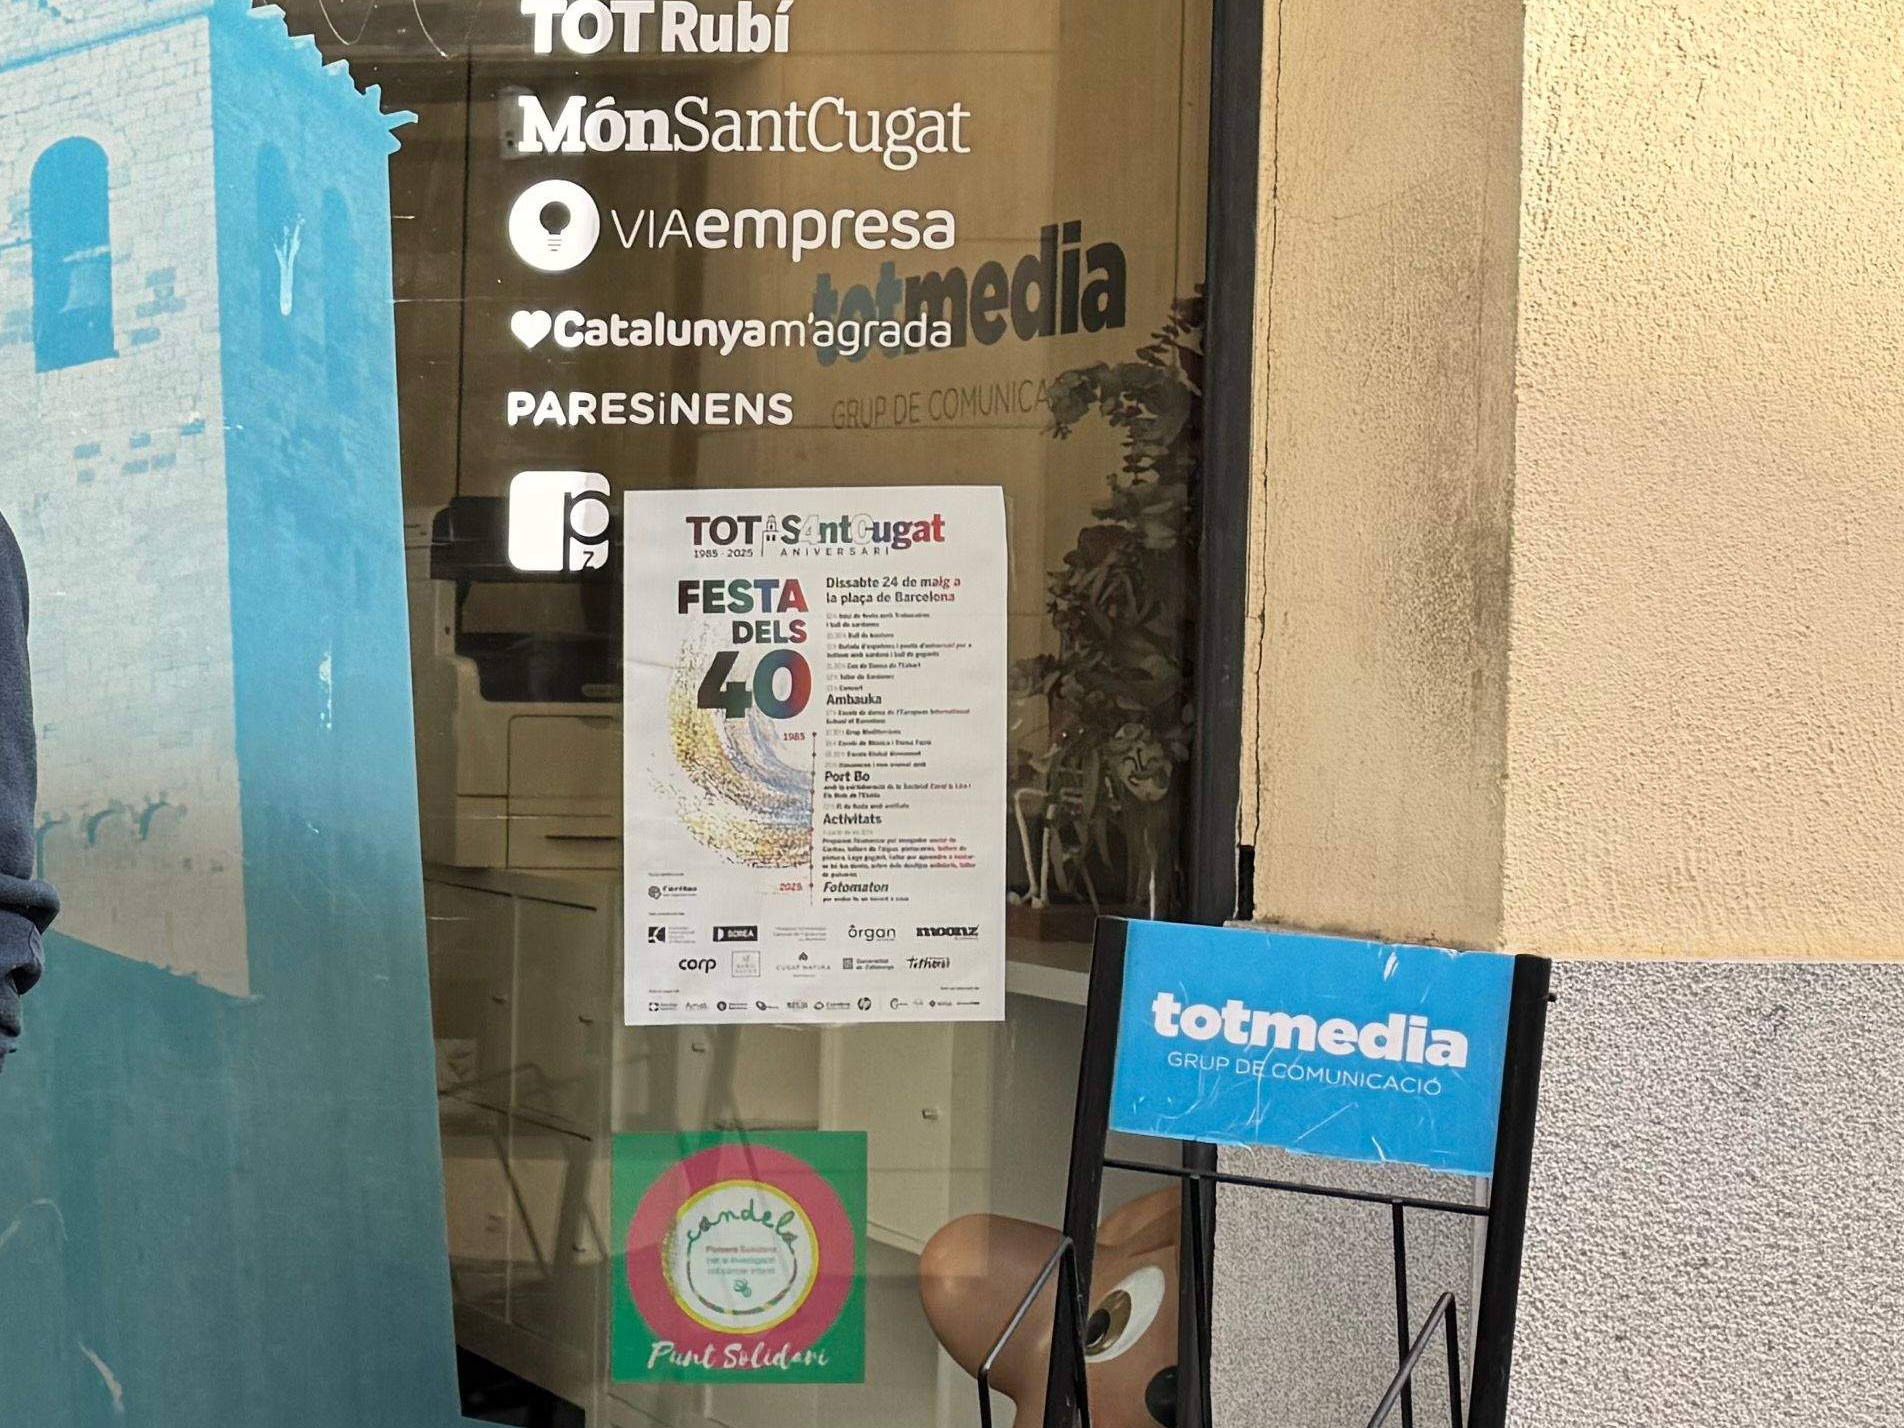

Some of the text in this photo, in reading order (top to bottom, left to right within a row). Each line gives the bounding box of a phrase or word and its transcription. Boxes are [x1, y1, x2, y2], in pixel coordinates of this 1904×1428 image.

[518, 94, 971, 170] MónSantCugat
[610, 207, 956, 262] VIAempresa
[811, 220, 1126, 366] totmedia
[506, 391, 794, 427] PARESiNENS
[832, 379, 1052, 429] GRUP DE COMUNICA
[686, 515, 762, 545] TOT
[780, 547, 889, 557] ANIVERSARI
[678, 578, 808, 614] FESTA
[826, 576, 879, 588] Dissabte
[882, 577, 898, 587] 24
[902, 576, 917, 587] de
[826, 591, 955, 605] la plaça de Barcelona
[732, 620, 807, 645] DELS
[697, 649, 812, 720] 40
[824, 771, 851, 782] Port
[823, 813, 882, 825] Activitats
[823, 881, 889, 893] Fotomaton
[679, 958, 716, 973] corp
[1152, 992, 1469, 1068] totmedia
[1168, 1050, 1441, 1096] GRUP DE COMUNICACIÓ
[647, 1340, 829, 1369] Punt Solidari
